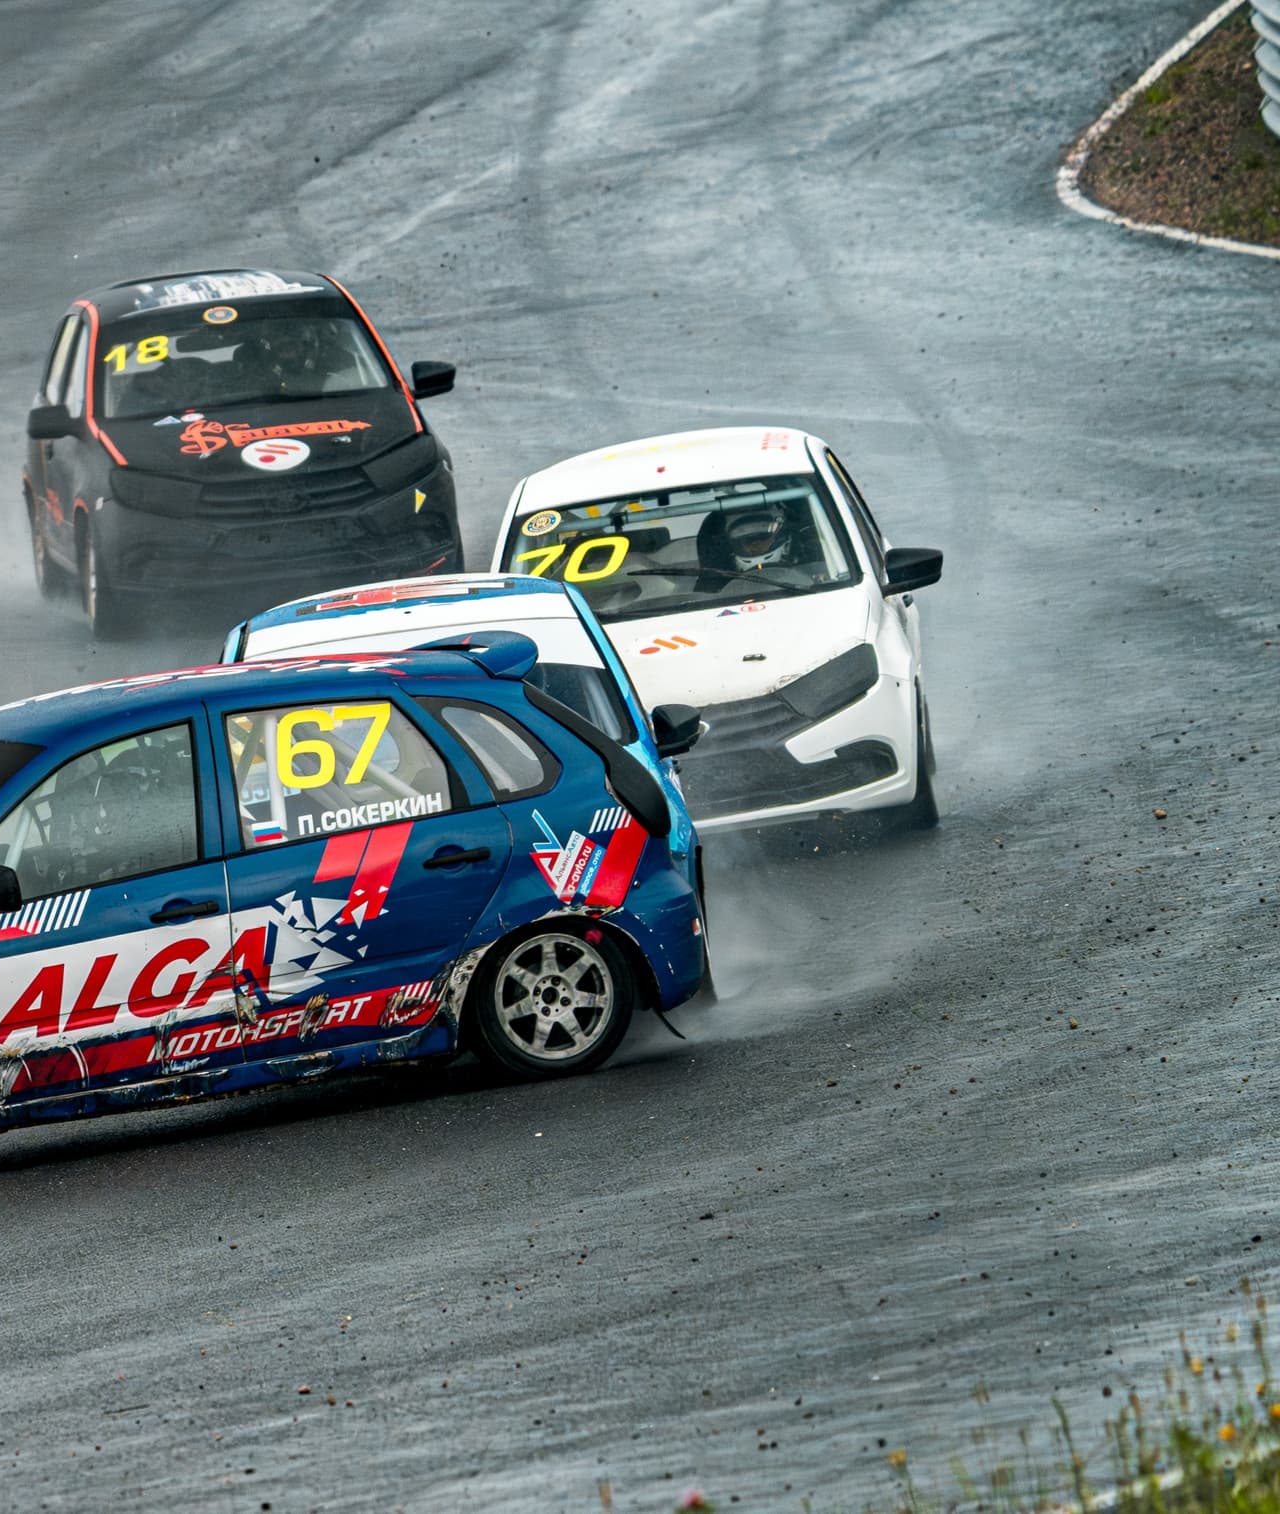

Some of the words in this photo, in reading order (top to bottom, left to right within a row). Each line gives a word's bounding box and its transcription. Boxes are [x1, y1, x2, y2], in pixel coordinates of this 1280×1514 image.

[103, 335, 169, 372] 18
[516, 536, 630, 582] 70
[276, 702, 391, 790] 67
[297, 792, 443, 836] П.СОКЕРКИН
